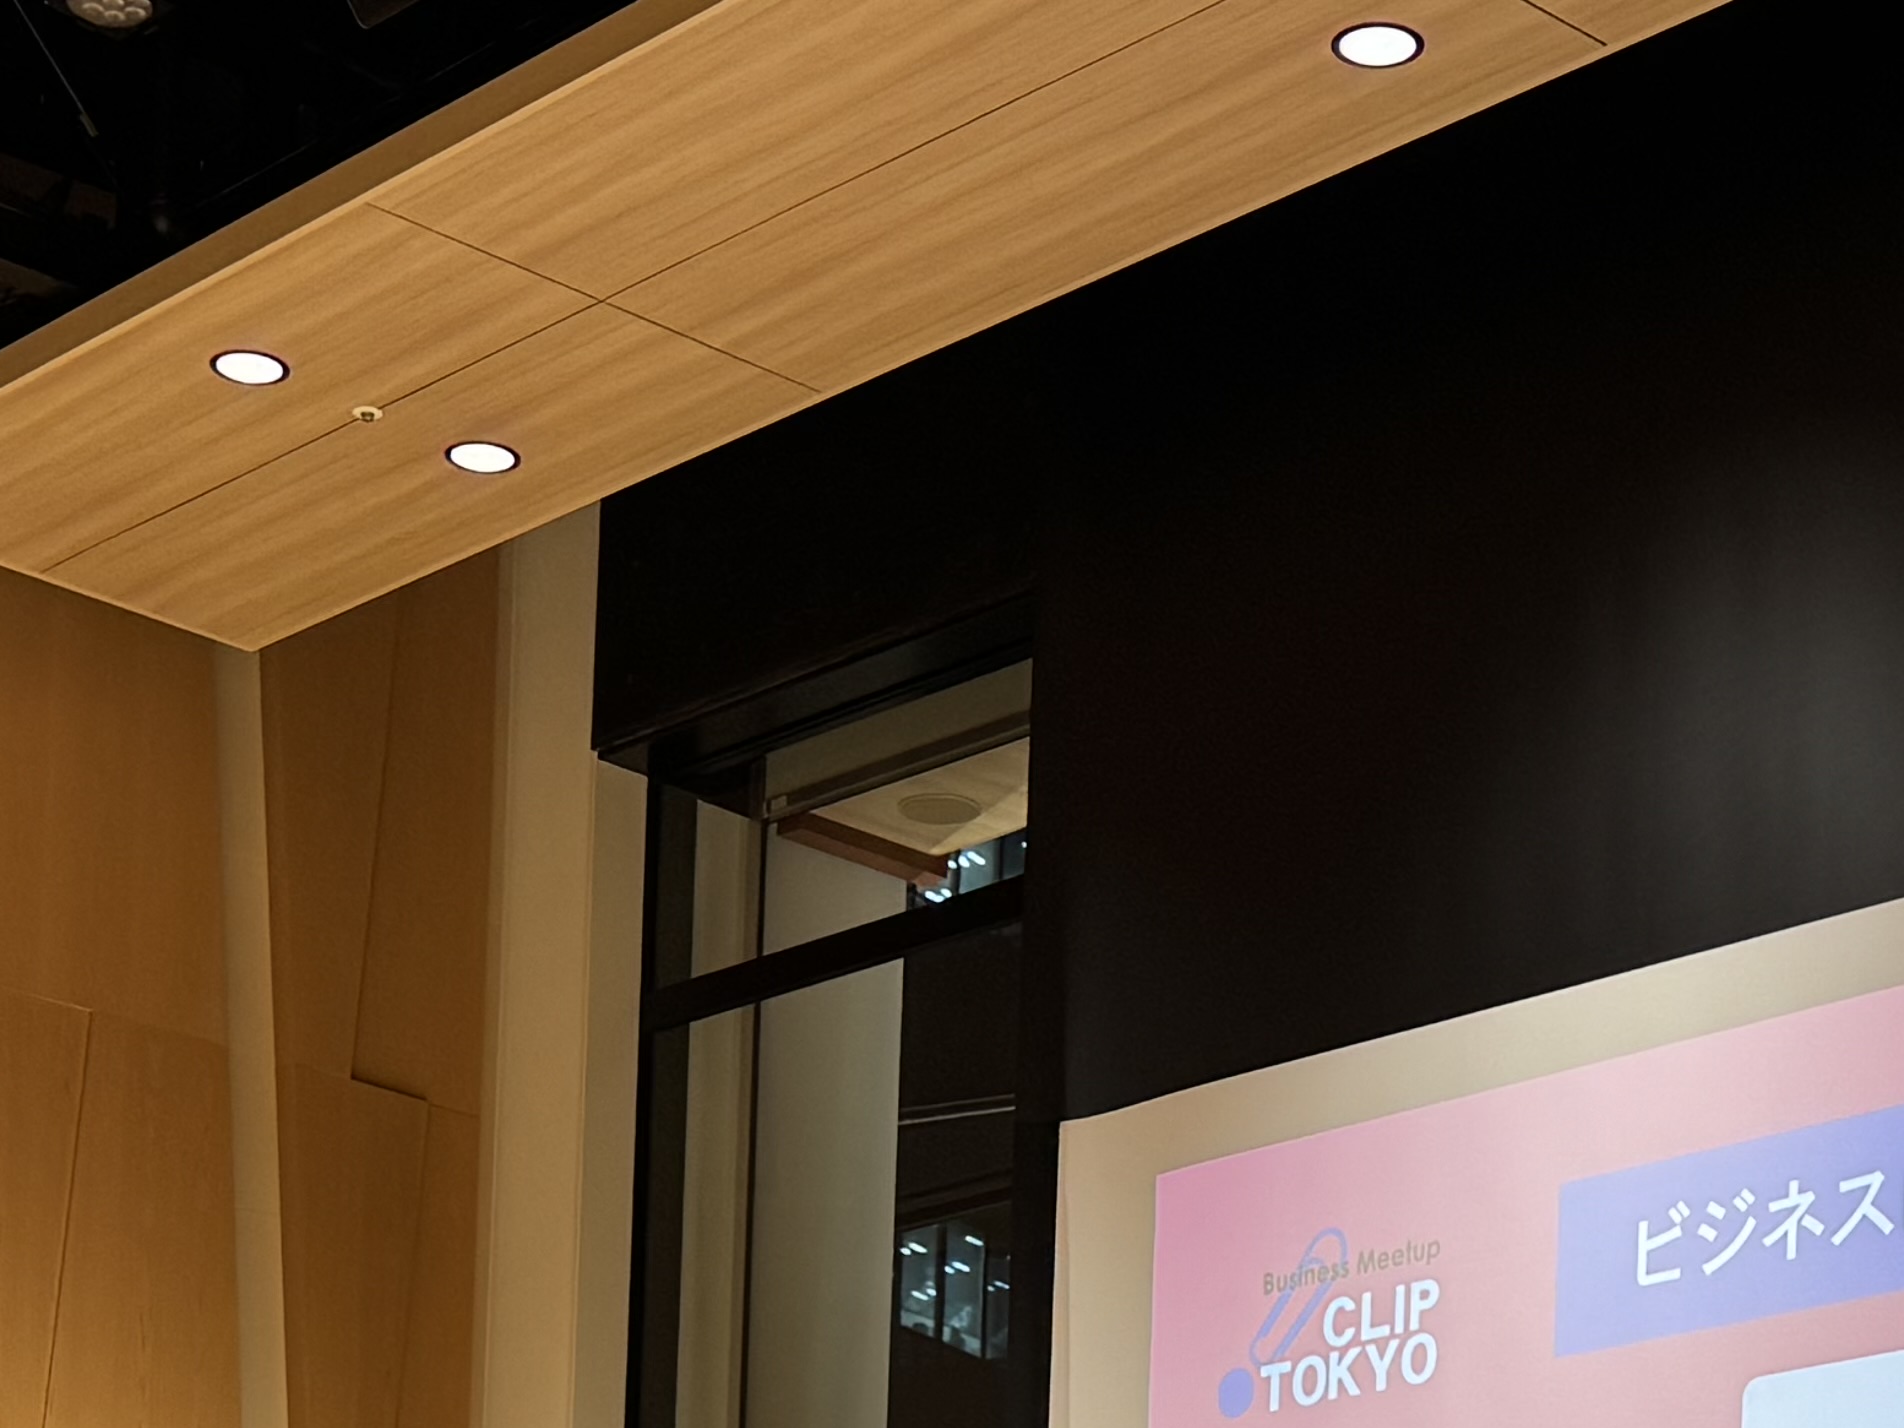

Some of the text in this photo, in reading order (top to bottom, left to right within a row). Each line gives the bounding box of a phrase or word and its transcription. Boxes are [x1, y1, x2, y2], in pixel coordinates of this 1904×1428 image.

[1263, 1240, 1440, 1295] Business Meetup
[1323, 1278, 1440, 1347] CLIP
[1260, 1332, 1438, 1412] TOKYO
